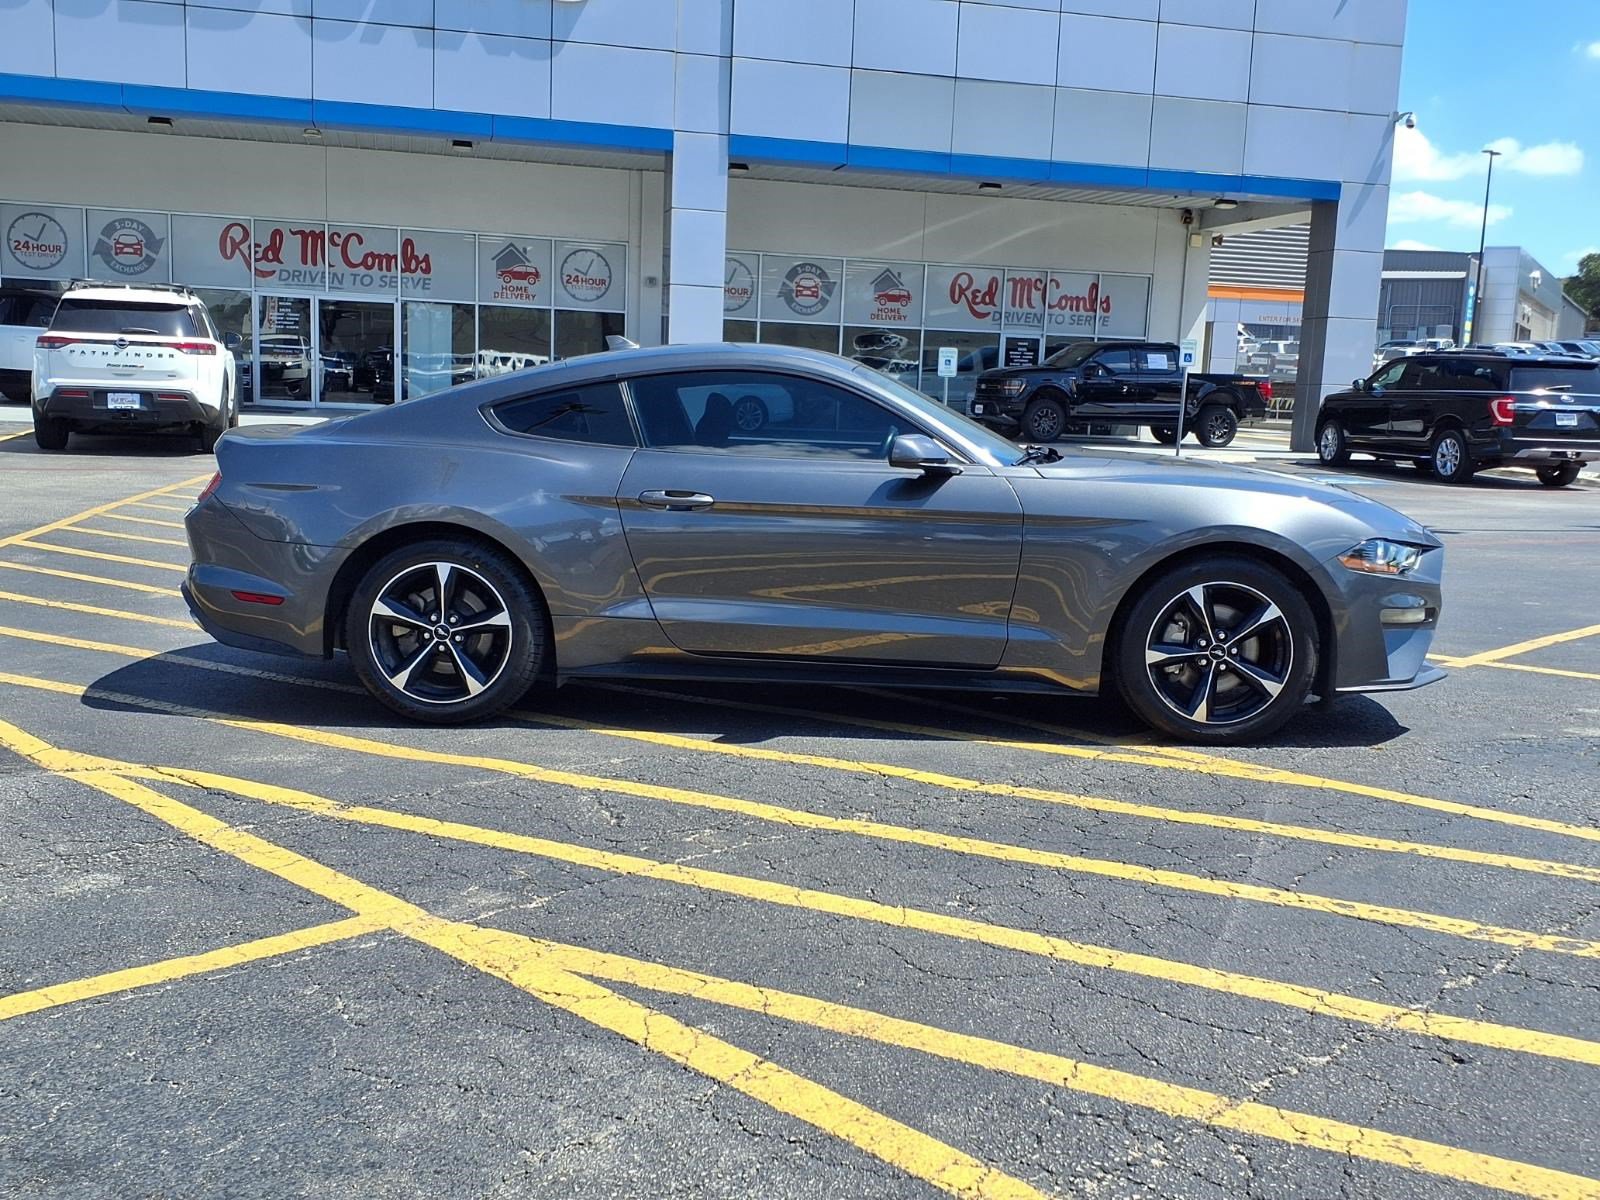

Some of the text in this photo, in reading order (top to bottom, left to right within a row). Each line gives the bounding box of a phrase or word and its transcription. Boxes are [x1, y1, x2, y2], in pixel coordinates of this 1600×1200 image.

[115, 219, 145, 233] 3-DAY
[13, 239, 62, 254] 24 HOUR
[219, 222, 432, 278] Red McCombs
[110, 261, 149, 274] EXCHANGE
[278, 269, 432, 291] DRIVEN TO SERVE
[565, 274, 607, 287] 24 HOUR
[492, 291, 537, 301] DELIVERY
[501, 285, 529, 294] HOME
[949, 271, 1112, 319] Red McCombs
[870, 312, 908, 322] DELIVERY
[877, 307, 902, 315] HOME
[991, 311, 1110, 328] DRIVEN TO SERVE
[69, 349, 175, 359] PATHFINDER
